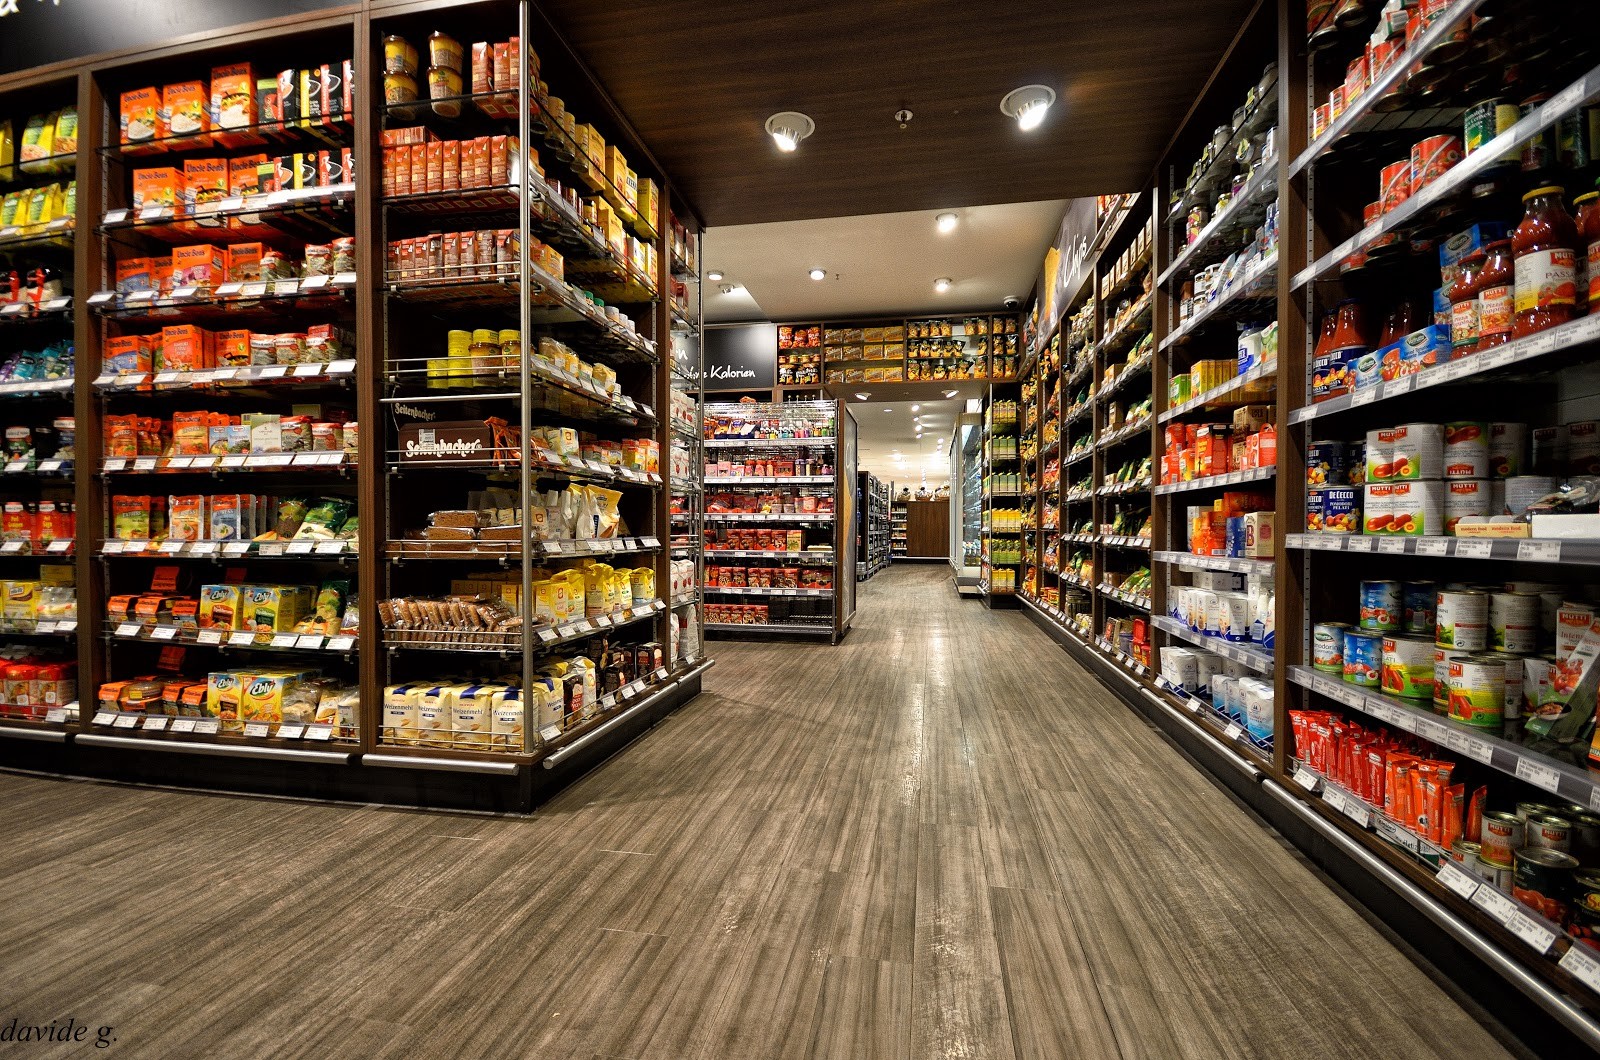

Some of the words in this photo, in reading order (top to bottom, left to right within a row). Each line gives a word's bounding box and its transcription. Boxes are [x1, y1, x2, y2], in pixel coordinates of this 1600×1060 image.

[186, 163, 205, 173] Uncle
[1485, 288, 1506, 296] MUTTI
[1486, 301, 1504, 309] Pizza
[710, 364, 756, 380] Kalorien
[394, 402, 434, 421] Seitenbacher
[211, 590, 229, 601] Ebly
[253, 592, 271, 603] Ebly
[217, 679, 234, 689] Ebly
[251, 680, 275, 696] Ebly
[384, 703, 413, 711] Weizenmehl
[1489, 823, 1510, 832] MUTTI
[1545, 829, 1565, 837] MUTTI
